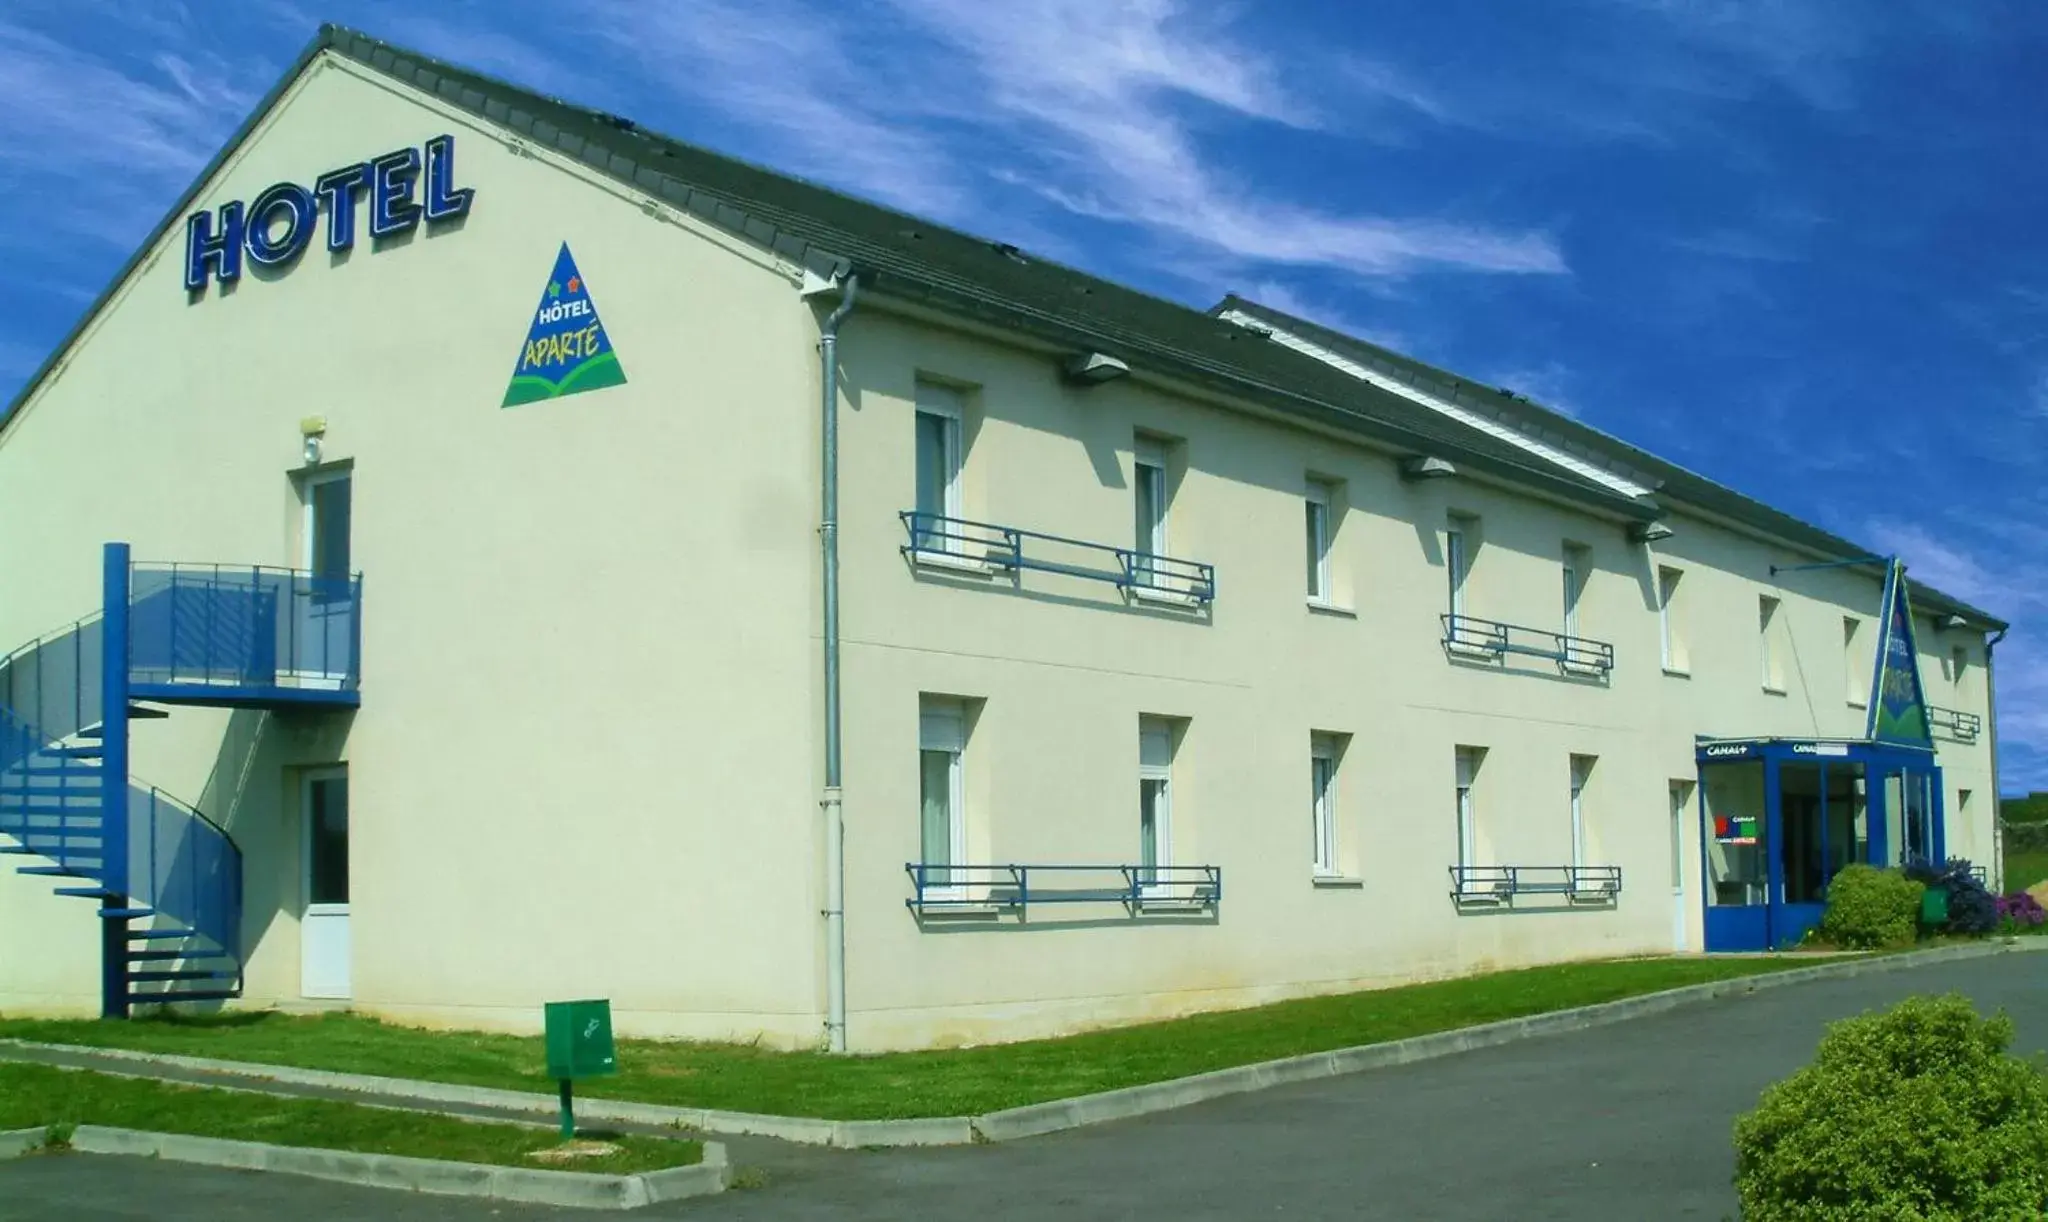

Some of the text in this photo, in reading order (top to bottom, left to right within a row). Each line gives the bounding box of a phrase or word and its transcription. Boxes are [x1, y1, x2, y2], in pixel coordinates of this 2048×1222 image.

[184, 134, 475, 291] HOTEL
[539, 299, 592, 325] HÔTEL
[522, 316, 600, 372] APARTÉ
